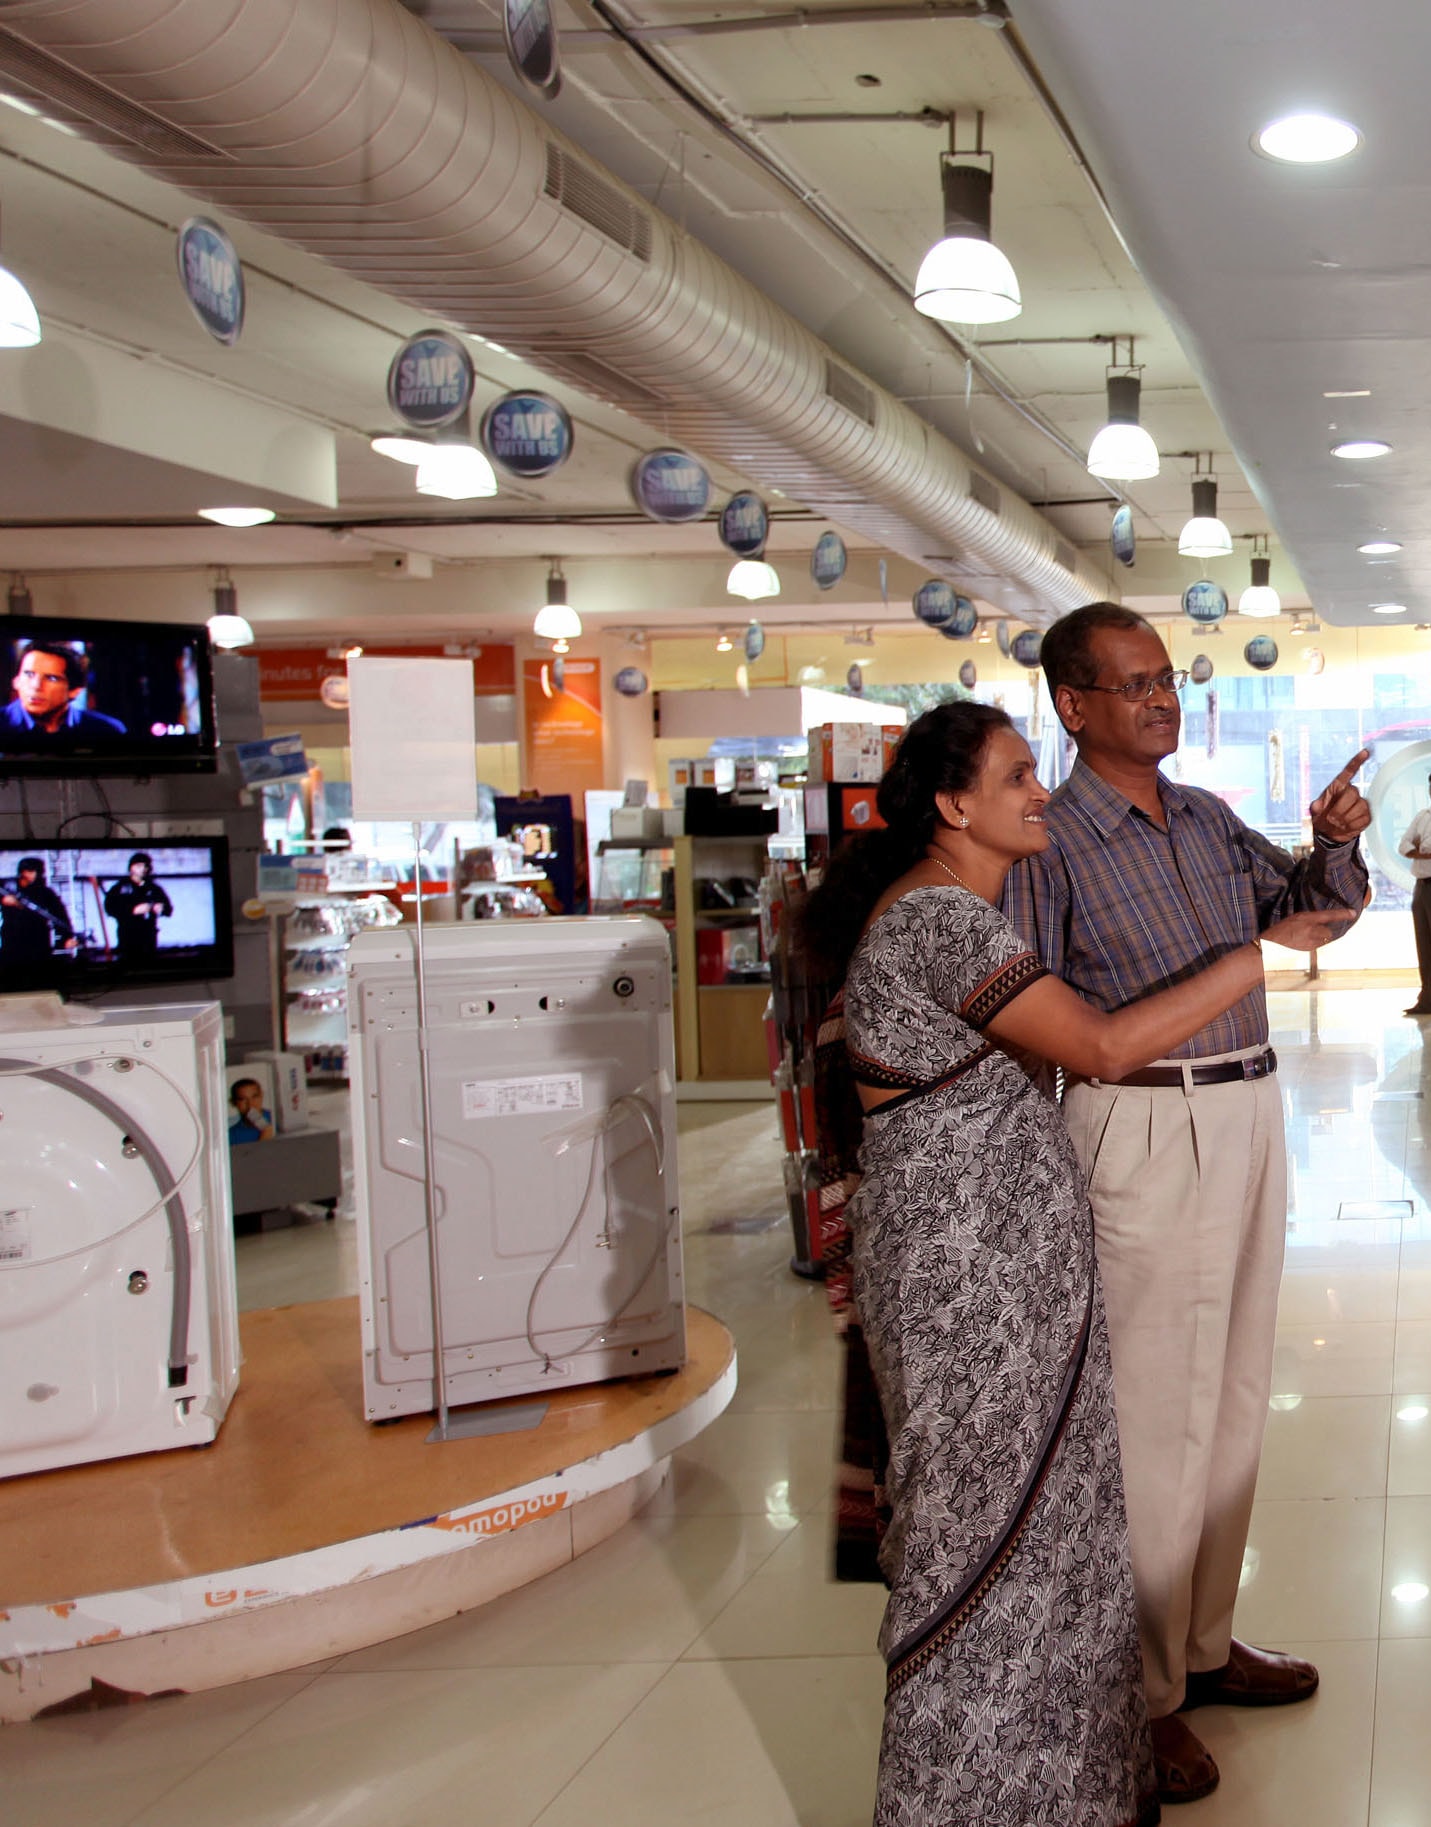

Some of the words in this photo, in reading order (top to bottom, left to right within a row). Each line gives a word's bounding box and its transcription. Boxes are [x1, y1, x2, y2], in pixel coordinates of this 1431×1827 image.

[401, 354, 459, 389] SAVE
[400, 387, 438, 407] WITH
[440, 386, 459, 404] US
[494, 413, 558, 441] SAVE
[495, 440, 537, 457] WITH
